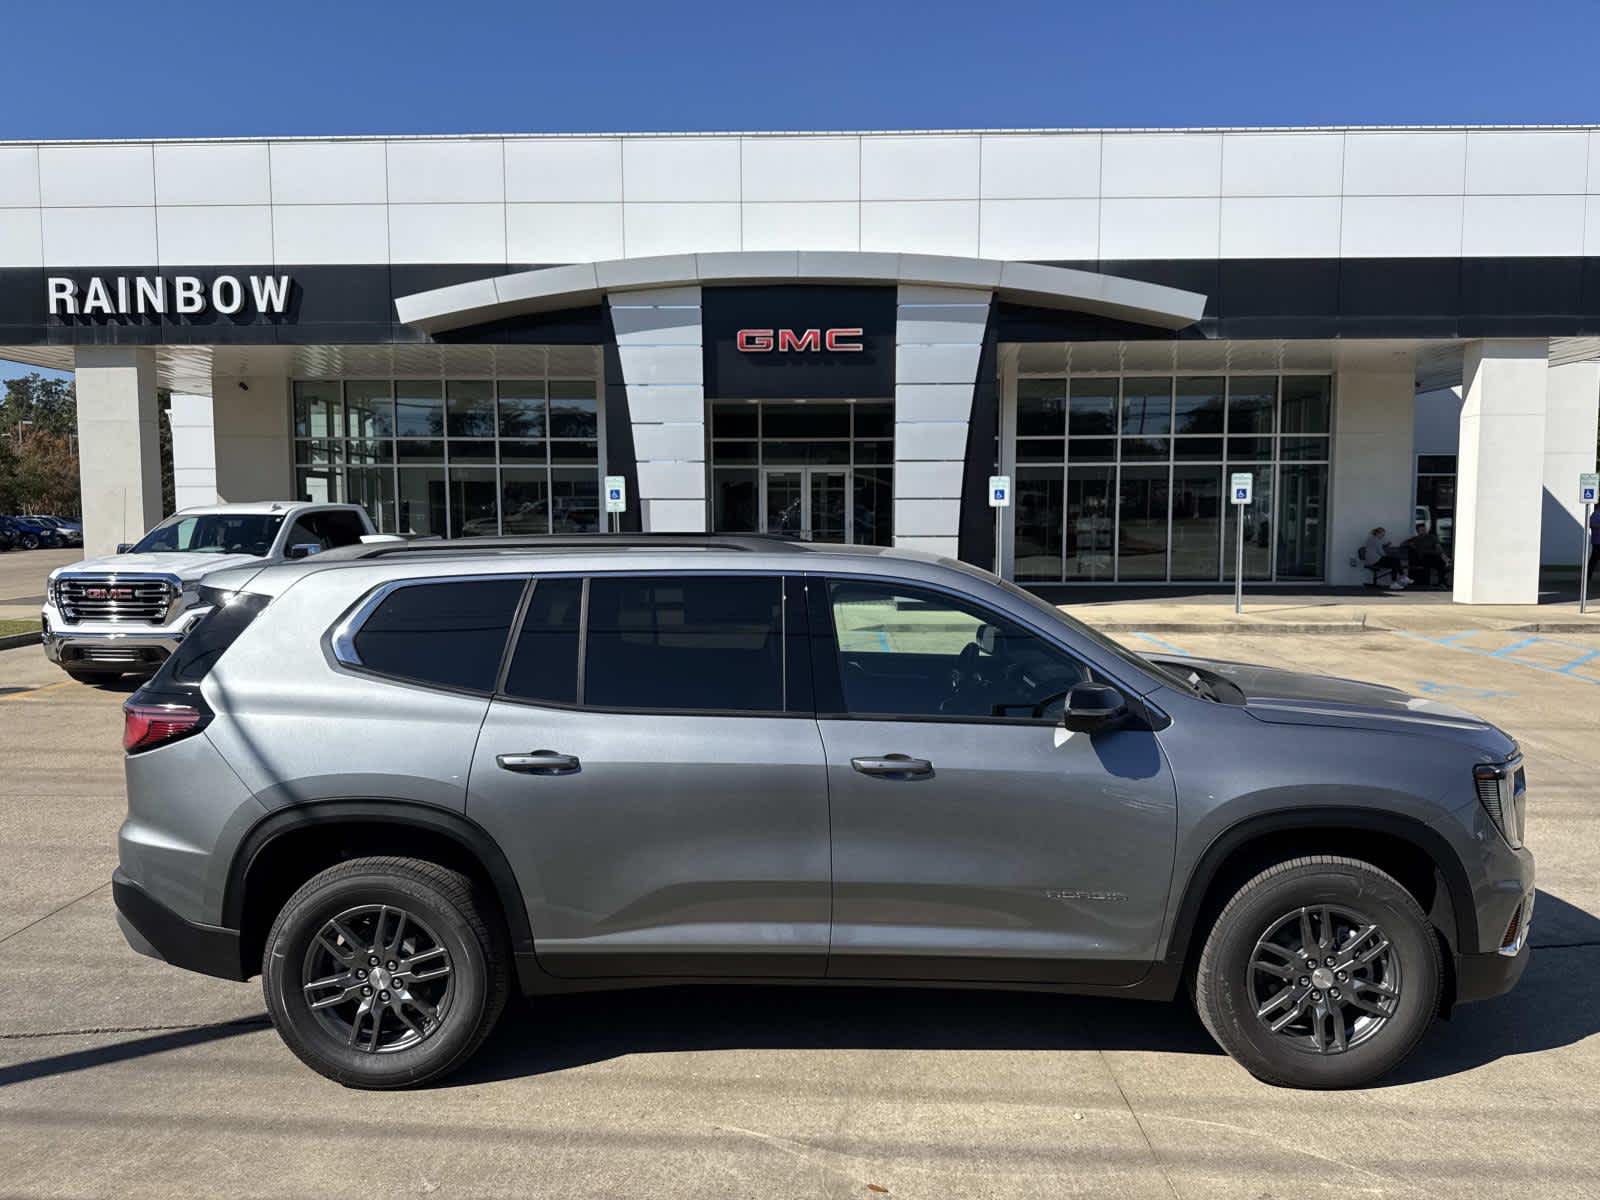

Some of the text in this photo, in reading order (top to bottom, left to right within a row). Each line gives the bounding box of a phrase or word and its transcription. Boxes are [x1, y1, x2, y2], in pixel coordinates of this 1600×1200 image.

[48, 275, 289, 314] RAINBOW
[737, 328, 863, 352] GMC
[86, 588, 132, 599] GMC
